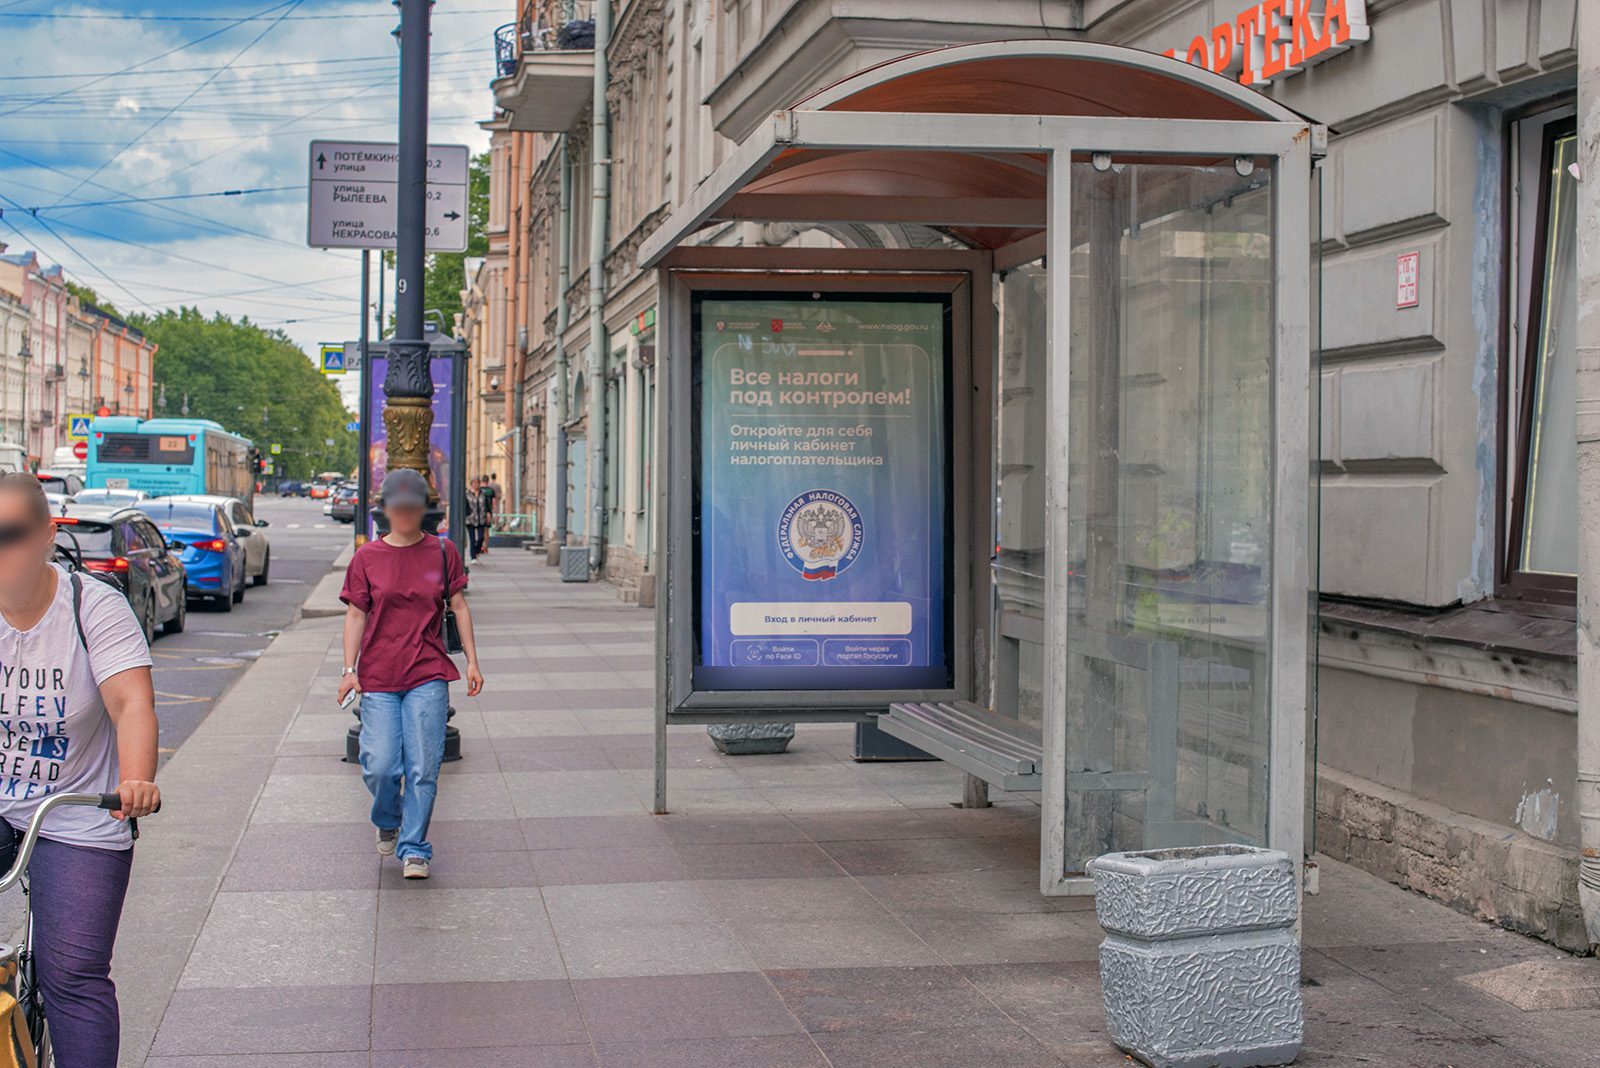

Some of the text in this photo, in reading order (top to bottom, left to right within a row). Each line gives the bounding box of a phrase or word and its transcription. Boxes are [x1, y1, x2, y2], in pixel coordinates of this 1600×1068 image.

[334, 164, 366, 173] улица
[333, 185, 365, 194] улица
[333, 192, 387, 204] РЫЛЕЕВА
[332, 220, 364, 229] улица
[332, 229, 398, 240] НЕКРАСОВА
[859, 322, 929, 333] www.nalog.gov.ru
[730, 368, 859, 386] Все налоги
[730, 388, 911, 408] под контролем!
[730, 425, 873, 438] Откройте для себя
[168, 440, 177, 448] 22
[730, 439, 856, 451] личный кабинет
[731, 455, 883, 467] налогоплательщика
[780, 493, 862, 560] ФЕДЕРАЛЬНАЯ НАЛОГОВАЯ СЛУЖБА
[764, 615, 788, 623] Вход
[798, 615, 836, 623] личный
[838, 615, 877, 623] кабинет
[772, 645, 795, 653] Войти
[4, 666, 64, 690] YOUR
